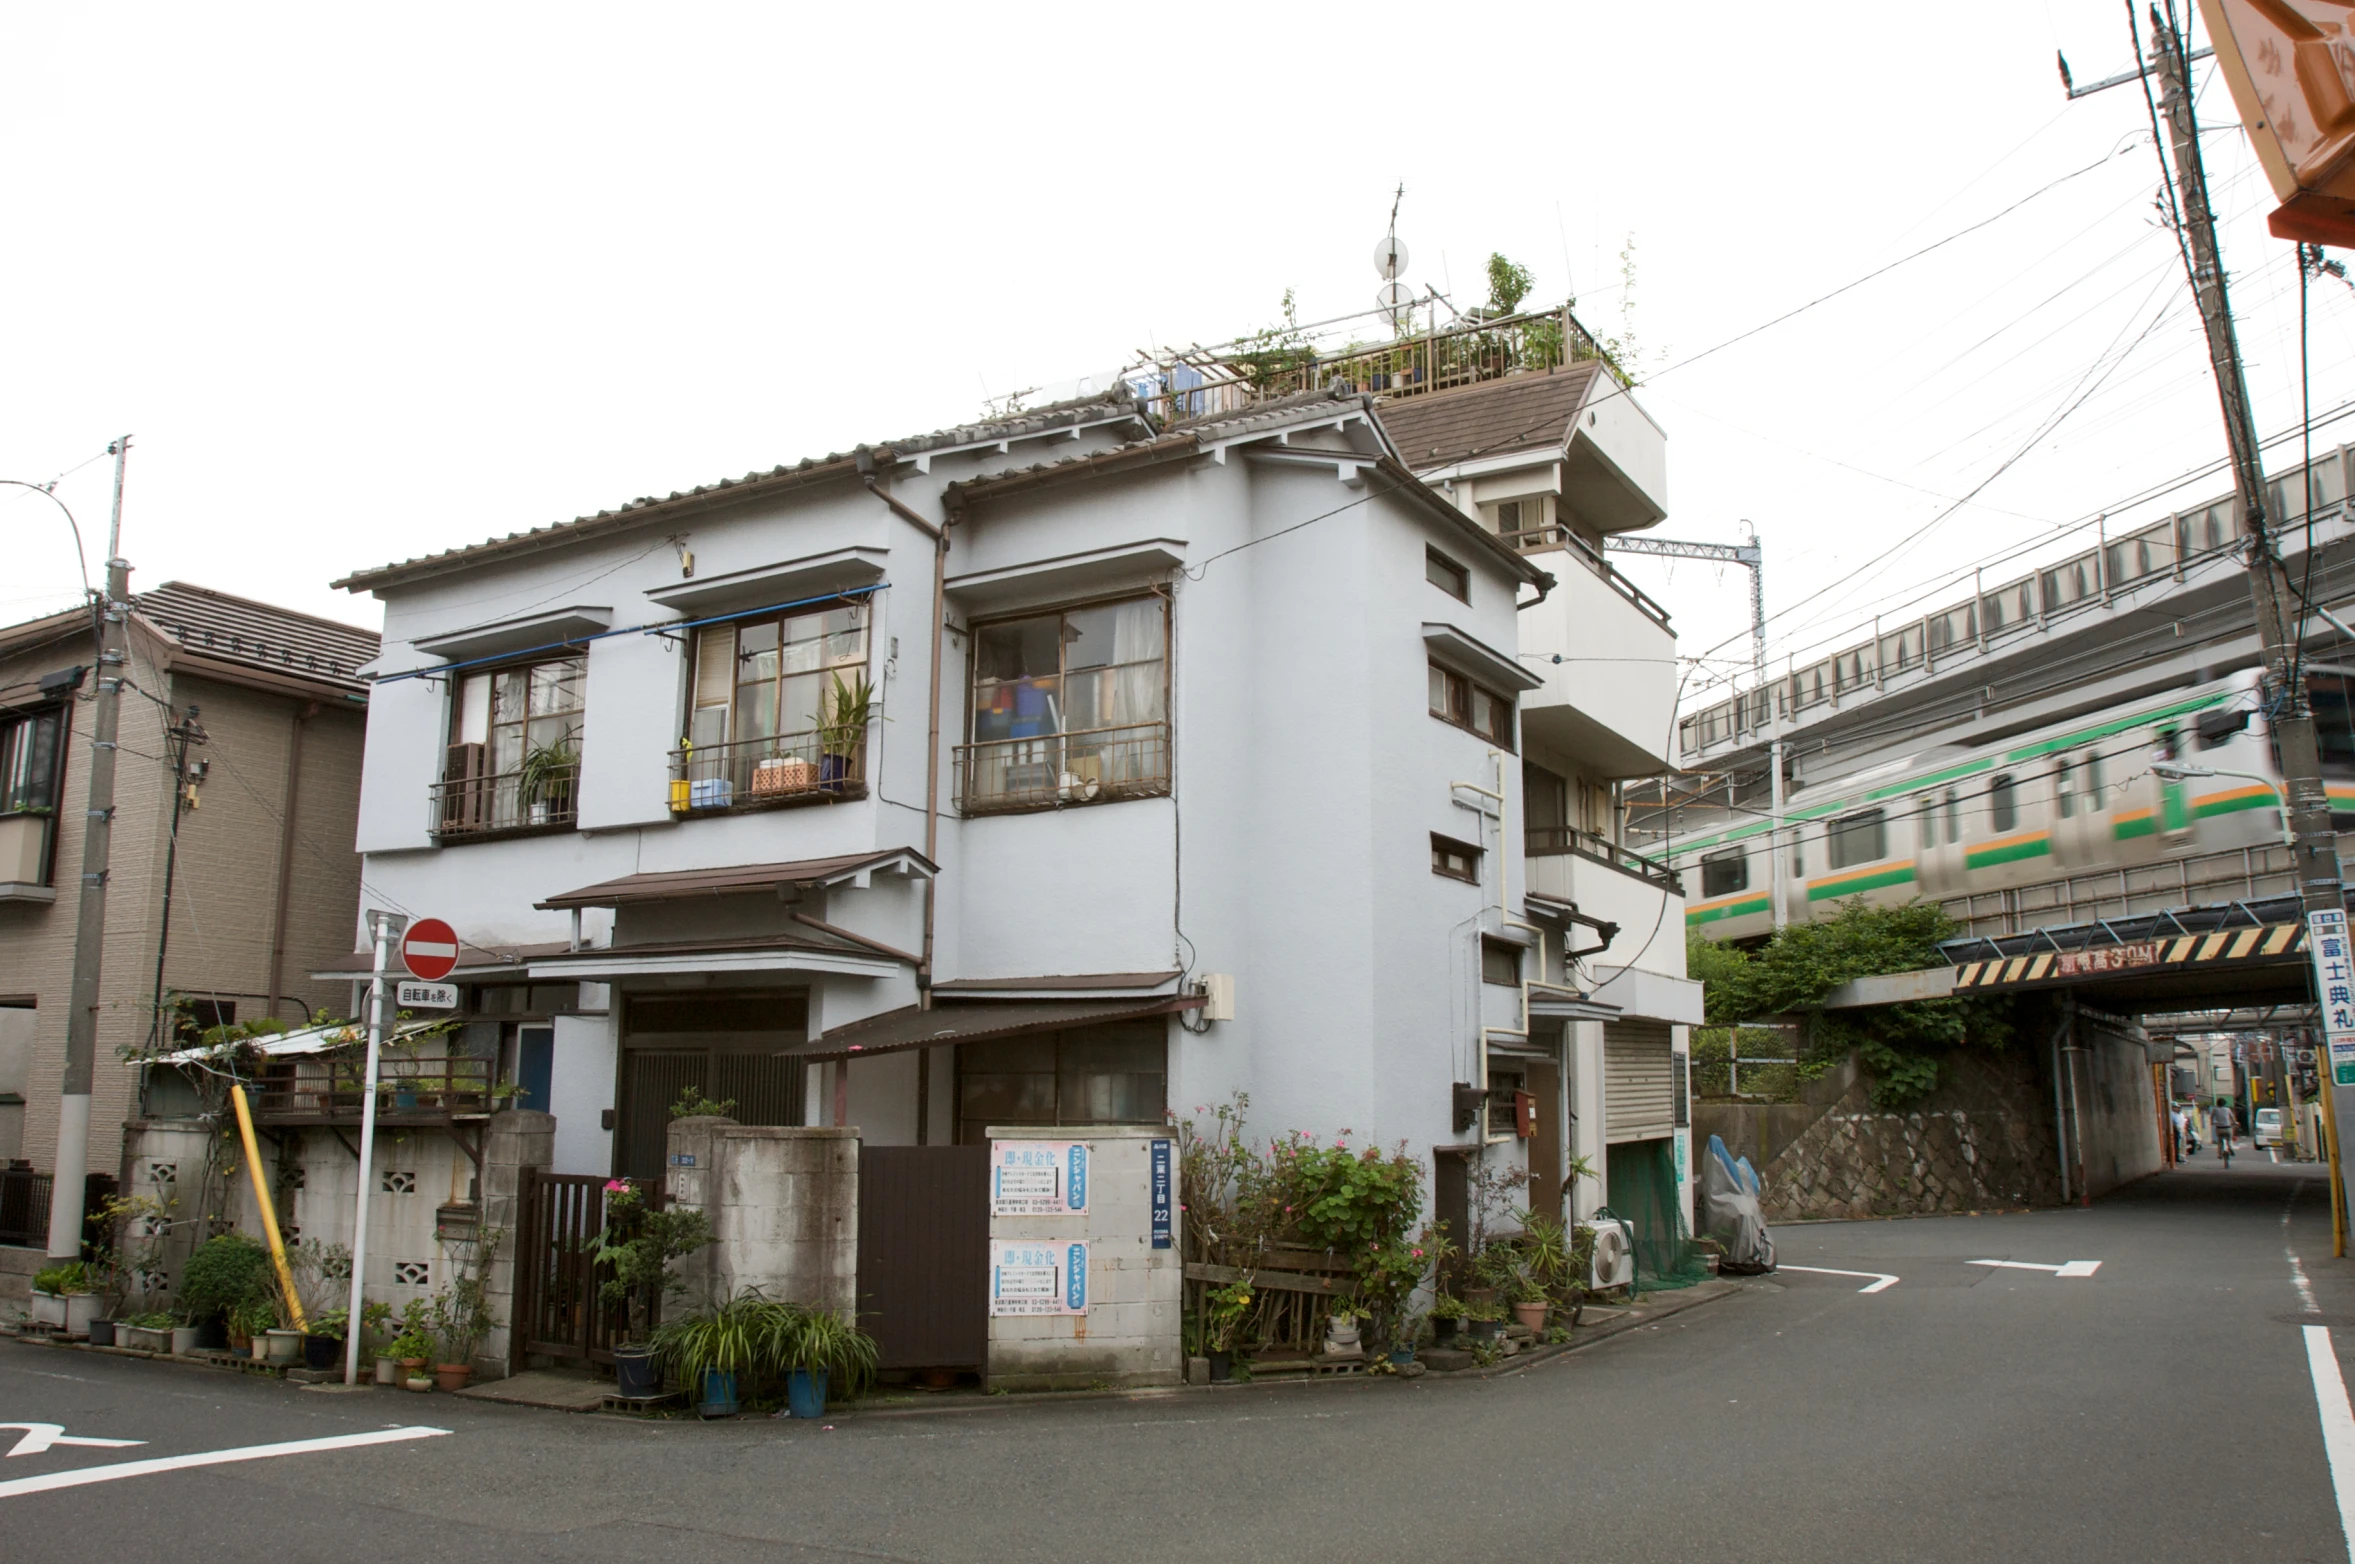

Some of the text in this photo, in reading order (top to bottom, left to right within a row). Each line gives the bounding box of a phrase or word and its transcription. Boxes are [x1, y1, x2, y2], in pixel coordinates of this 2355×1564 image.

[2321, 938, 2354, 1029] 富士典礼
[403, 988, 452, 1003] 自転車を除く
[1004, 1151, 1056, 1166] 即・現金化
[1156, 1155, 1166, 1204] 二葉二丁目
[1154, 1209, 1168, 1221] 22
[1004, 1250, 1056, 1266] 即・現金化
